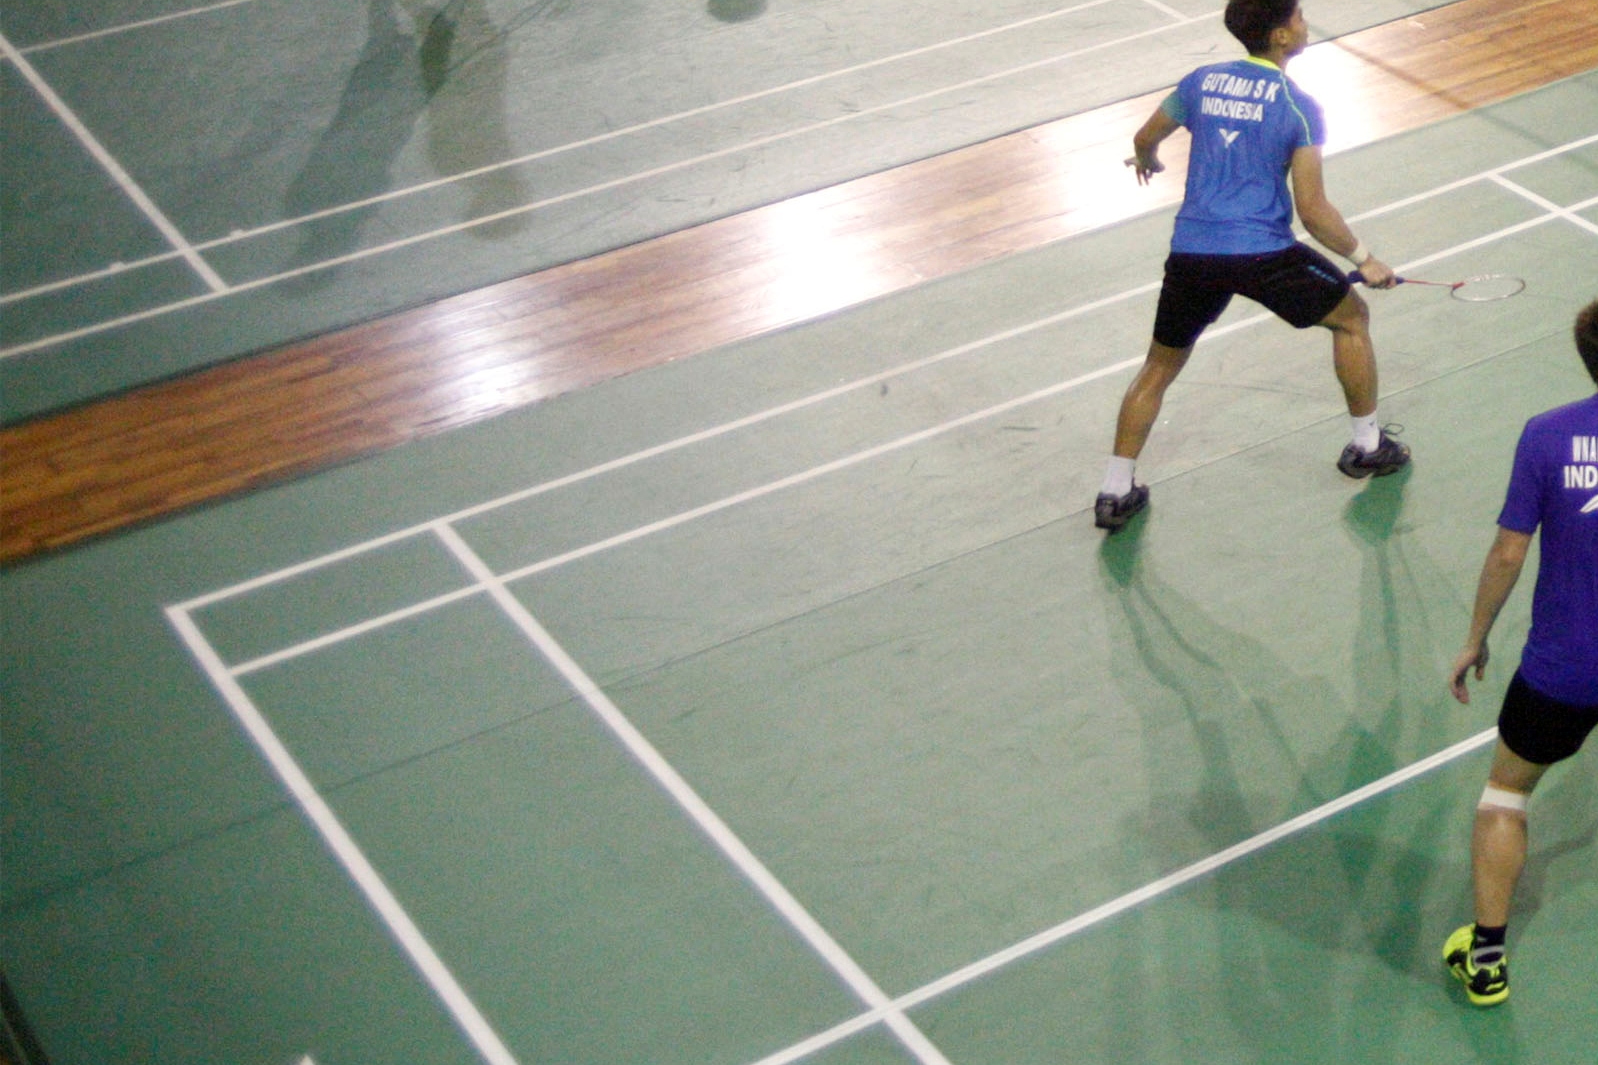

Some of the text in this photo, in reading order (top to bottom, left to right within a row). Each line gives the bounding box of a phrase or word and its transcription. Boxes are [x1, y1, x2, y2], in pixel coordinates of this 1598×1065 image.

[1253, 79, 1265, 99] S
[1265, 82, 1281, 102] K
[1201, 96, 1264, 122] INDONESIA
